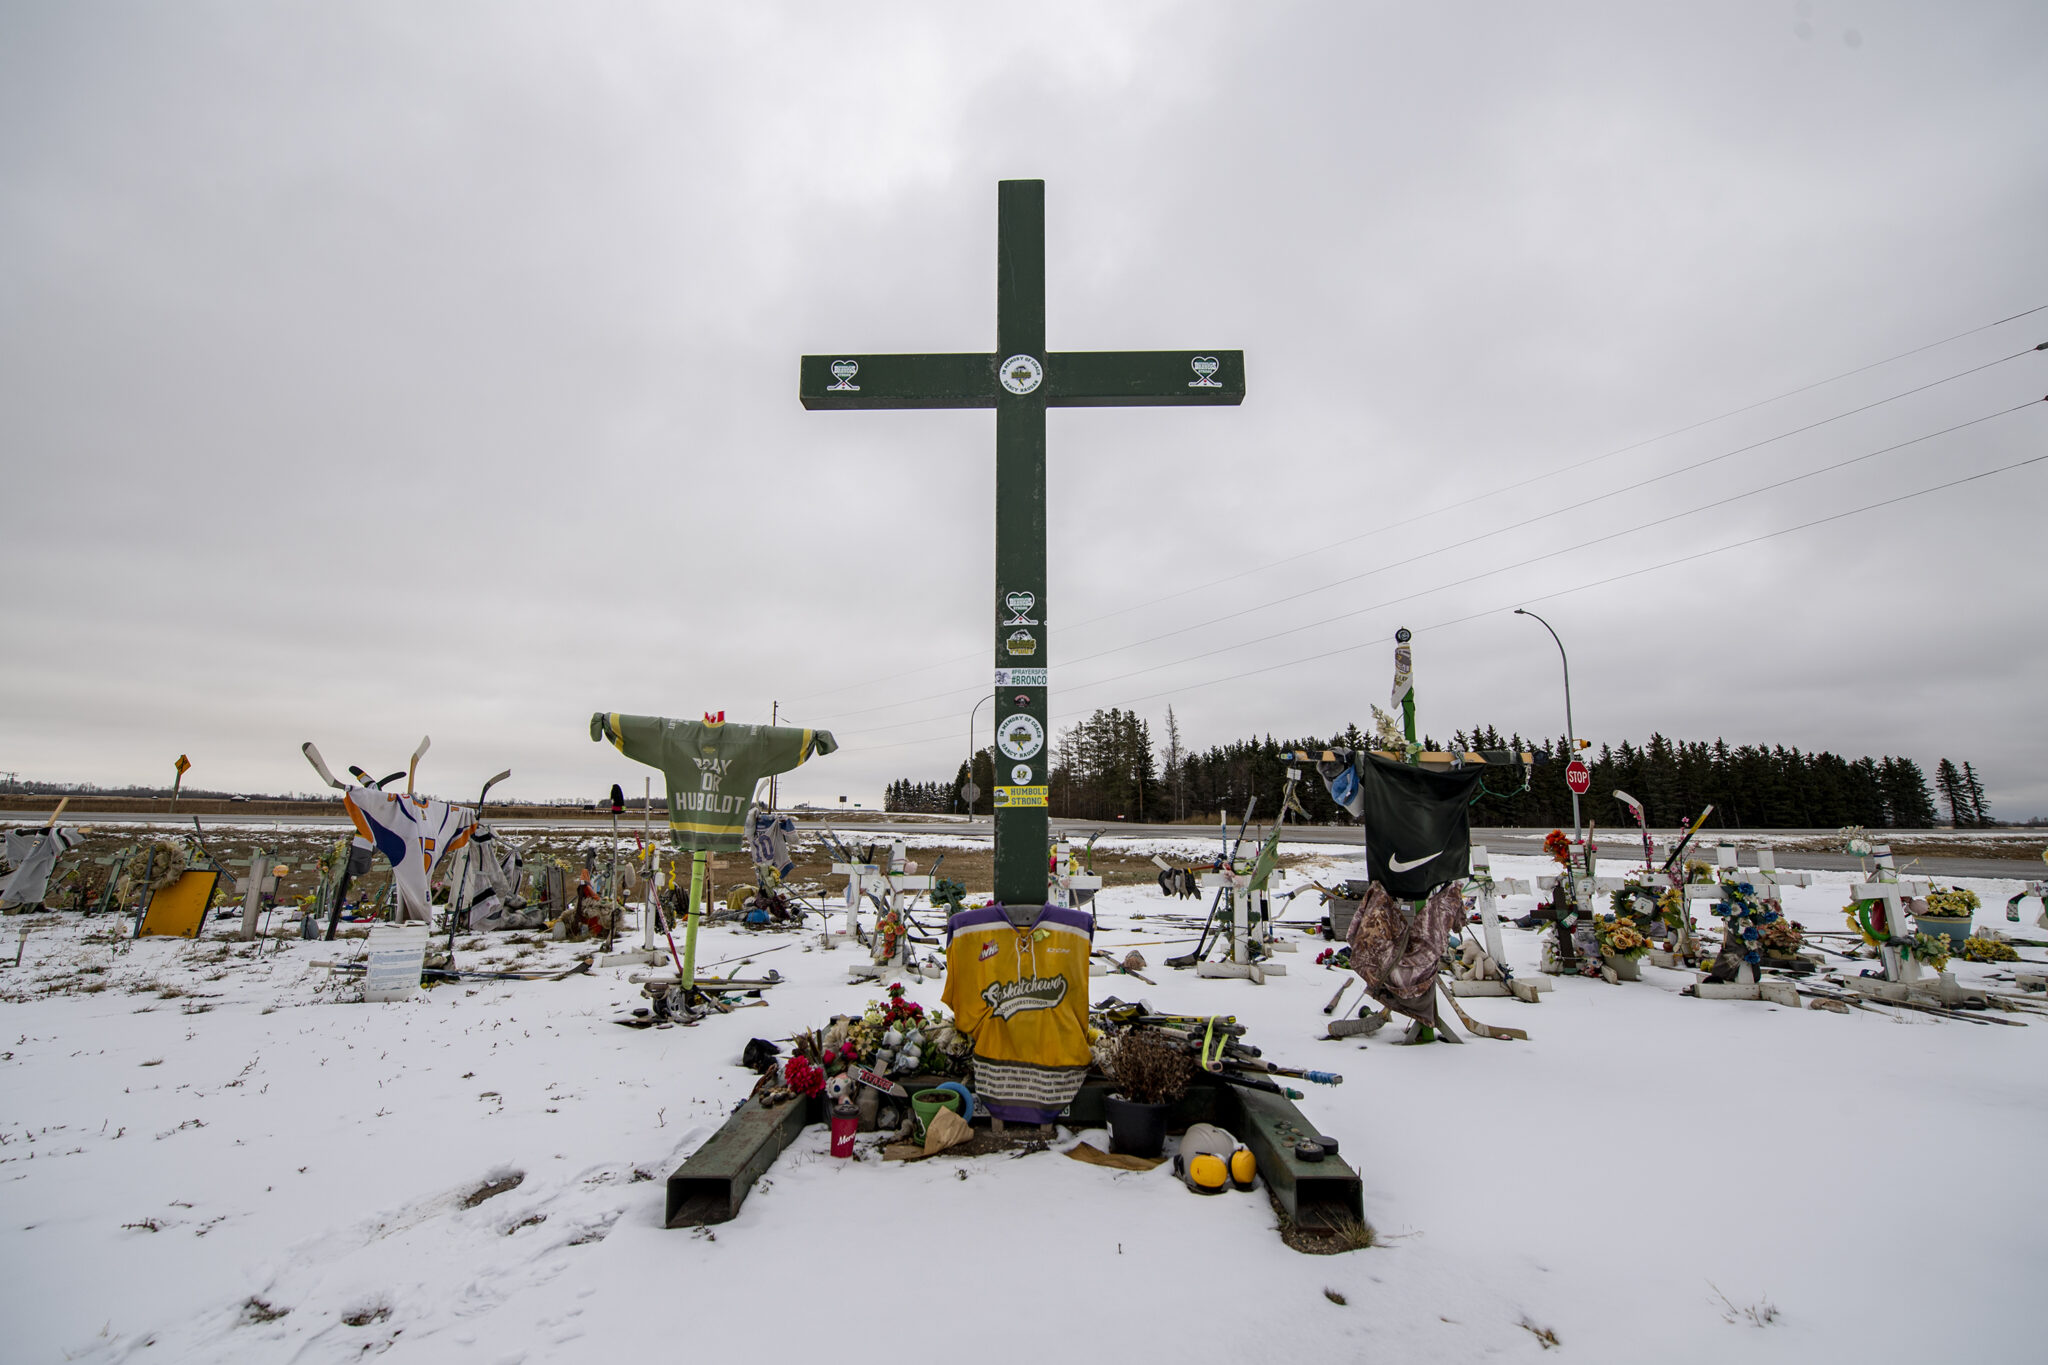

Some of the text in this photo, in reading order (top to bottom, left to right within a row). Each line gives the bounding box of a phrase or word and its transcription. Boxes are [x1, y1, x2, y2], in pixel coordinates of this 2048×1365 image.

[1005, 357, 1023, 368] MEMORY
[1011, 675, 1047, 685] #BRONCO
[1002, 716, 1024, 730] MEMORY
[1031, 720, 1041, 738] COACH
[1001, 743, 1018, 758] DARCY
[701, 772, 723, 792] OR
[1568, 770, 1588, 784] STOP
[1010, 788, 1047, 796] HUMBOLD
[1011, 797, 1042, 805] STRONG
